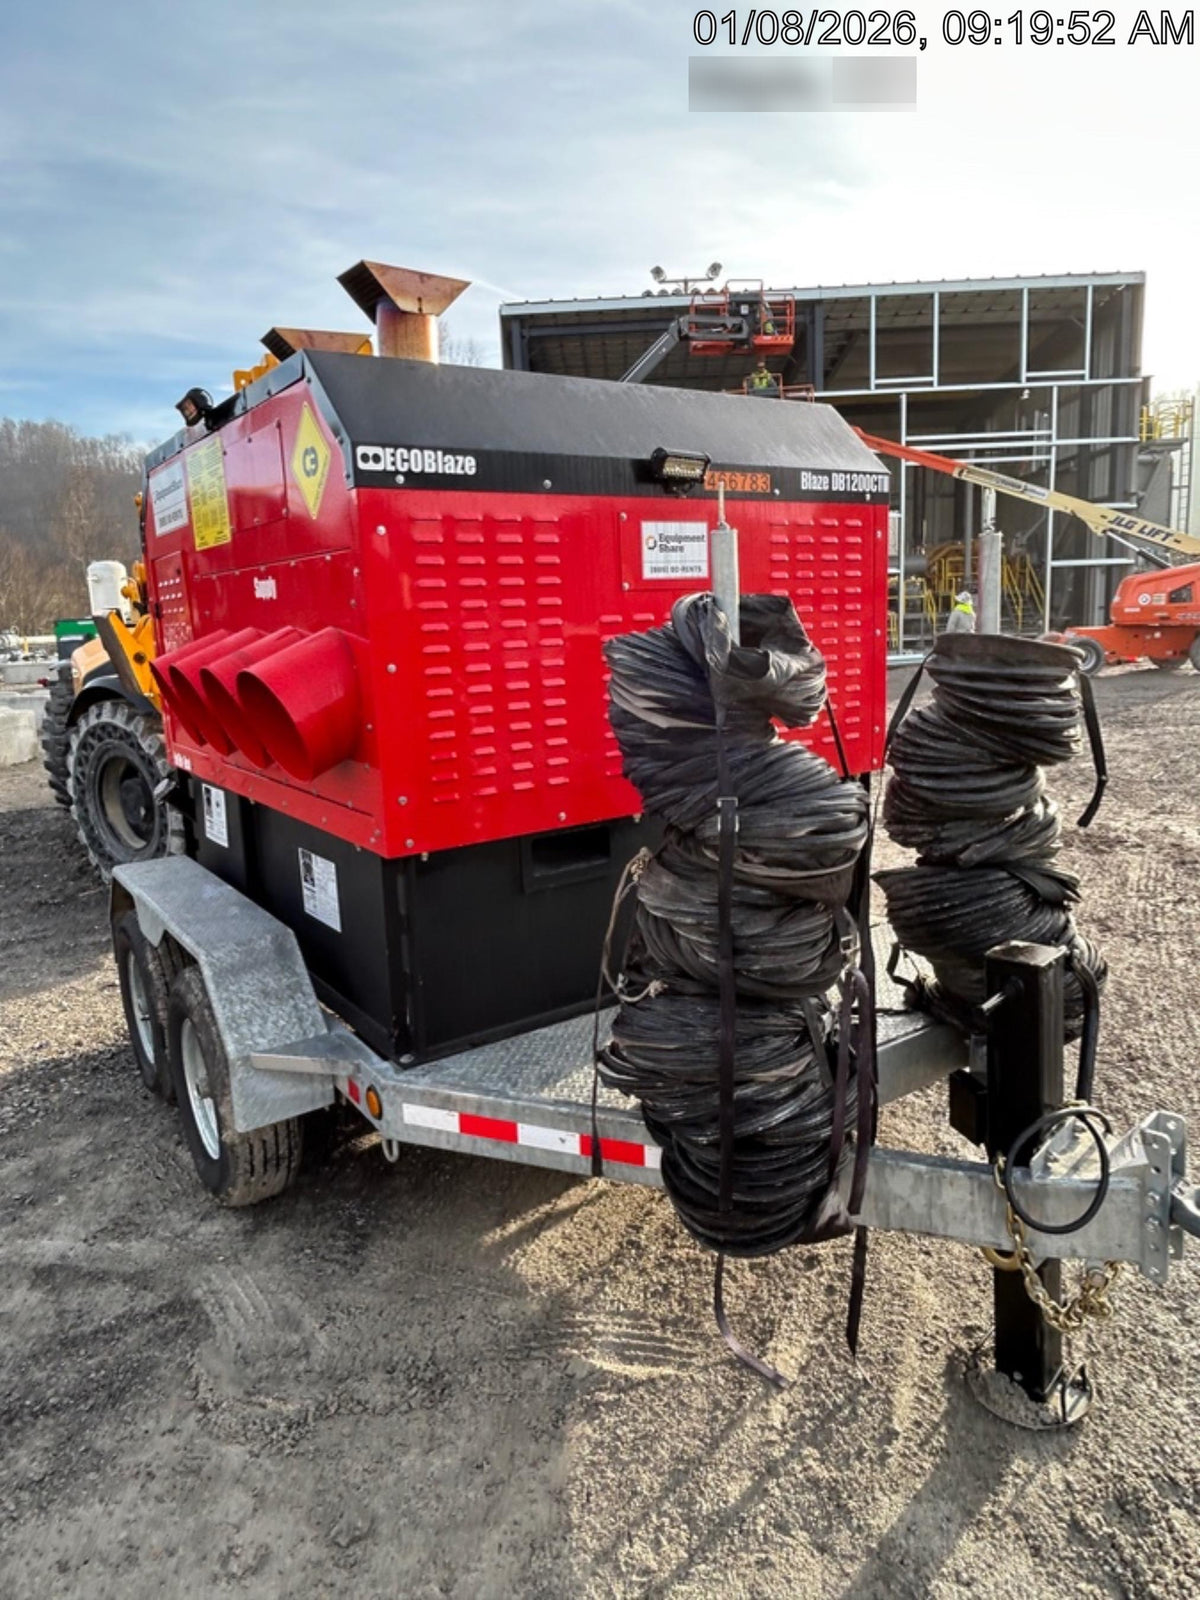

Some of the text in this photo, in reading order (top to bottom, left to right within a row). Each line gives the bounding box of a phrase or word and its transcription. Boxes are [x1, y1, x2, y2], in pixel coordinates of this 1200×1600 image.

[384, 448, 477, 475] ECOBlaze
[706, 472, 769, 492] 466783
[801, 471, 830, 490] Blaze
[1107, 515, 1174, 542] JLG LIFT
[658, 533, 705, 544] Equipment
[658, 543, 685, 553] Share
